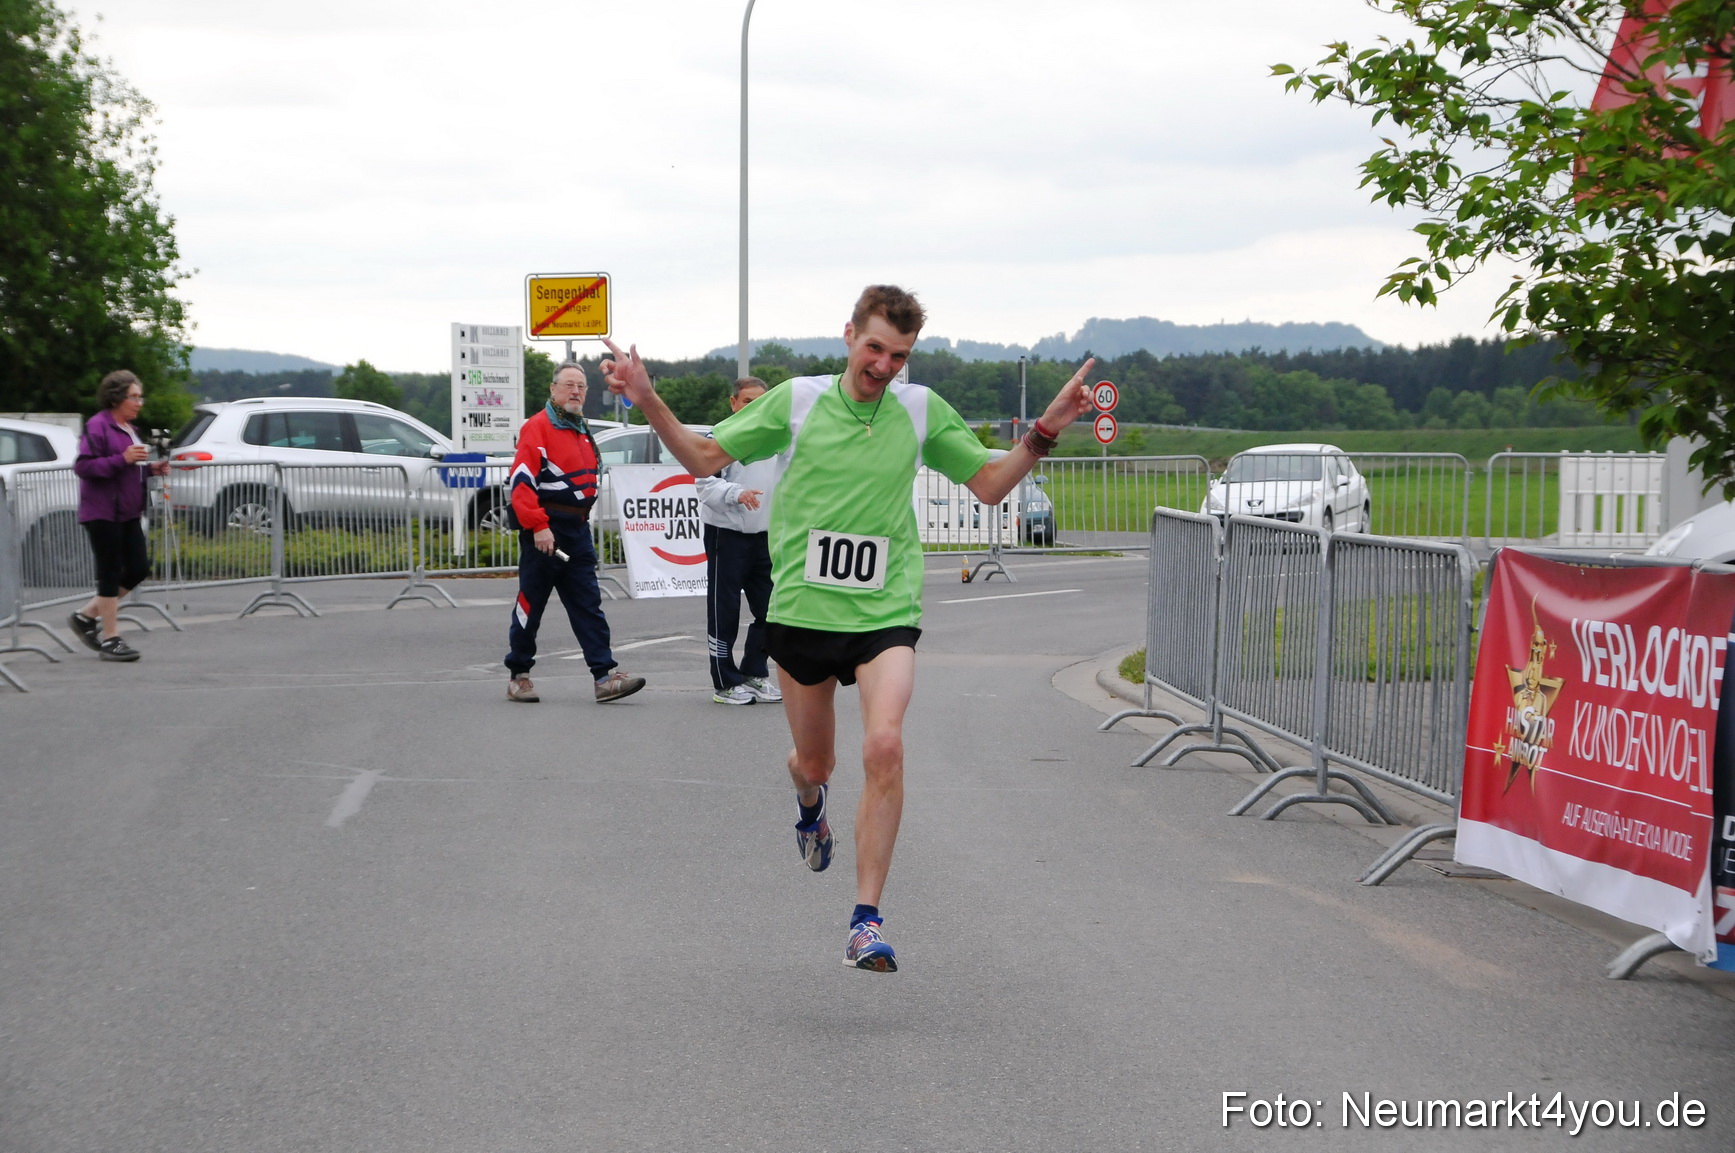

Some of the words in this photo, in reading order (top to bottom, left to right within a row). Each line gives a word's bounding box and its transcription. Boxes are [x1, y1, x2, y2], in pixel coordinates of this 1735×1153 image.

[536, 283, 601, 303] Sengenthal
[564, 303, 592, 314] Anger
[1098, 389, 1112, 403] 60
[468, 412, 491, 427] THULE
[624, 520, 665, 532] Autohaus
[818, 536, 877, 582] 100
[1561, 801, 1582, 828] AUF
